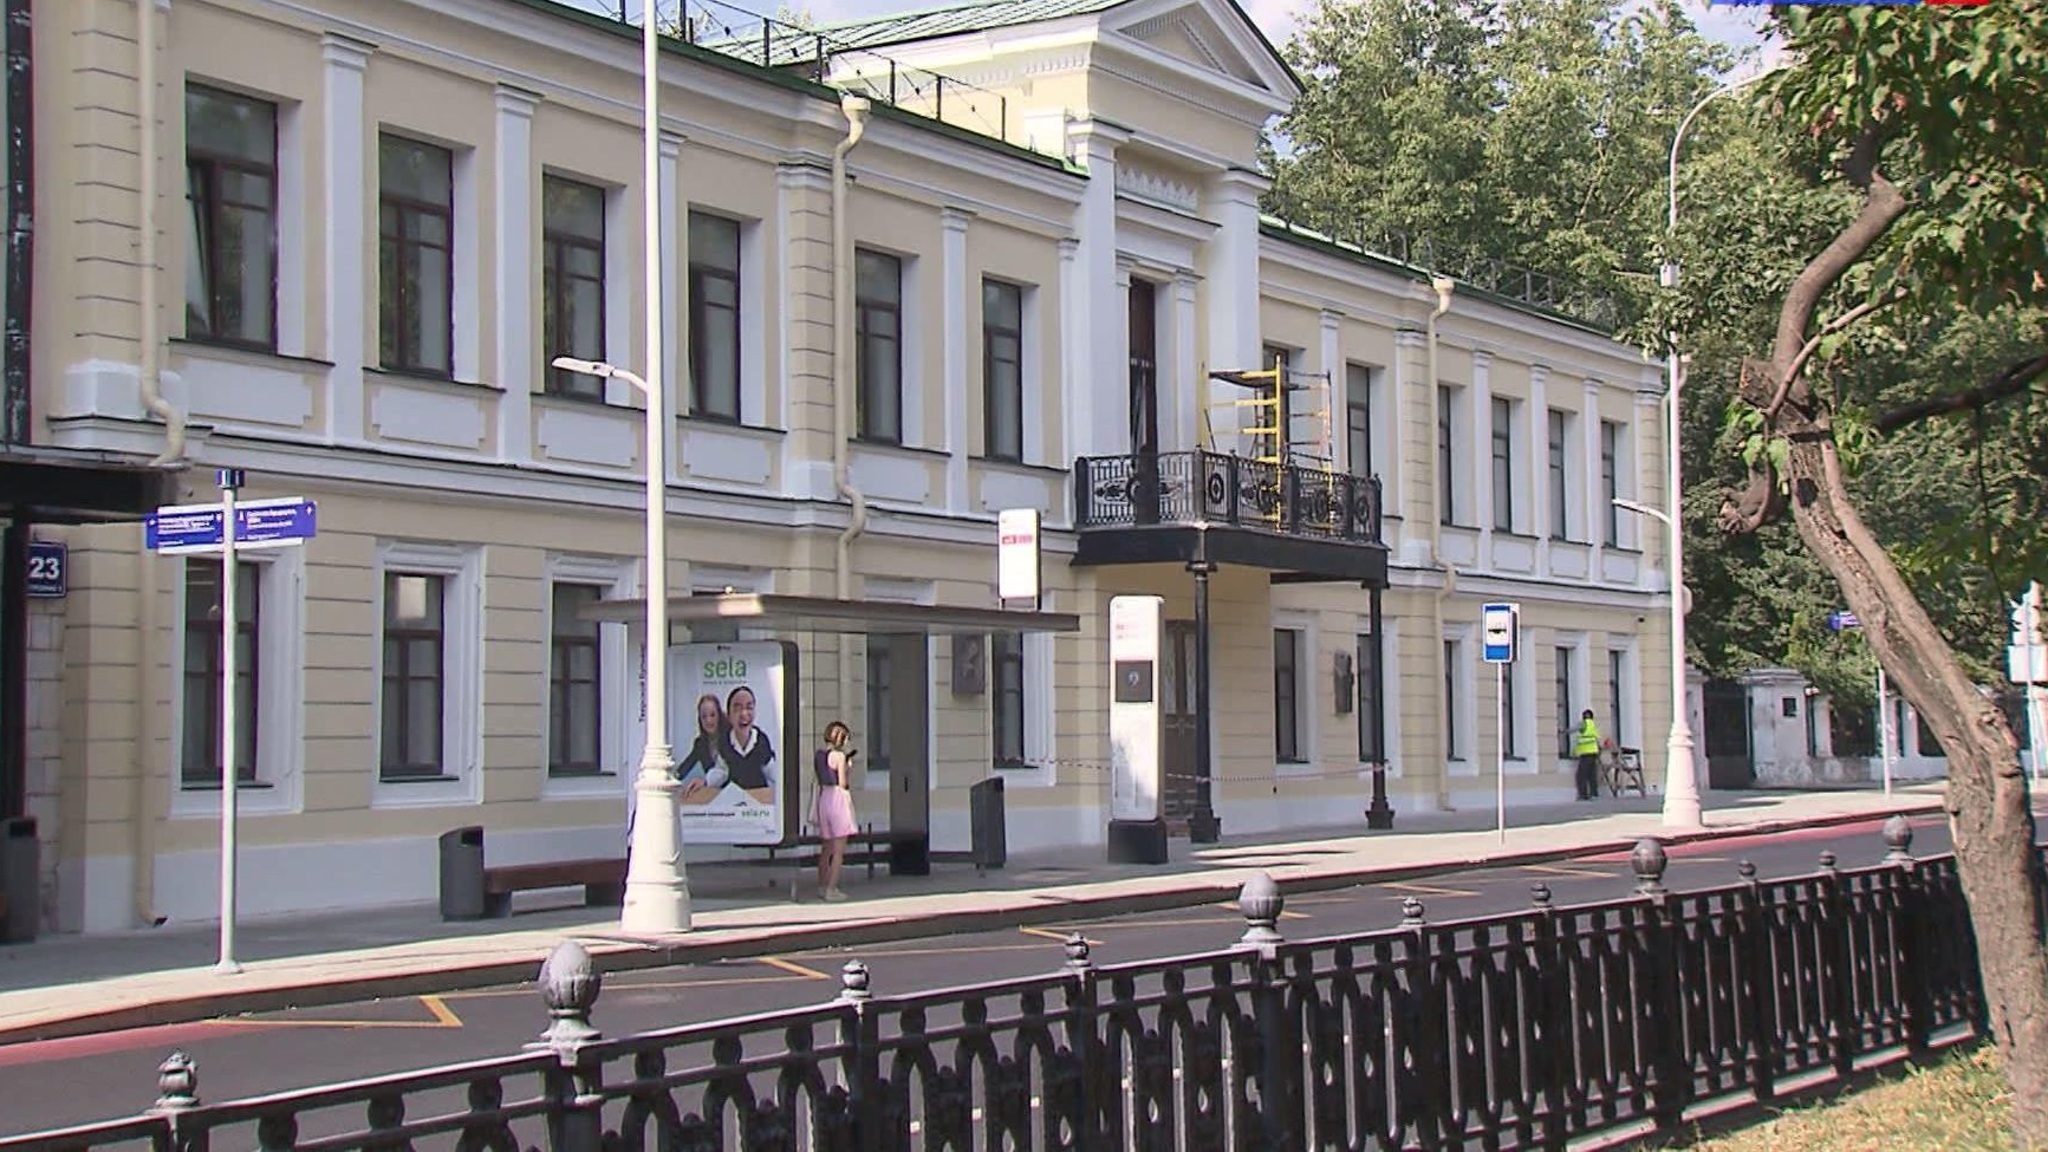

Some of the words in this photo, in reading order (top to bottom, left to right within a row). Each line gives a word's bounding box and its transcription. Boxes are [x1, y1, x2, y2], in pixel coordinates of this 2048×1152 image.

[29, 556, 60, 580] 23
[703, 655, 747, 679] sela
[741, 808, 770, 817] sela.ru
